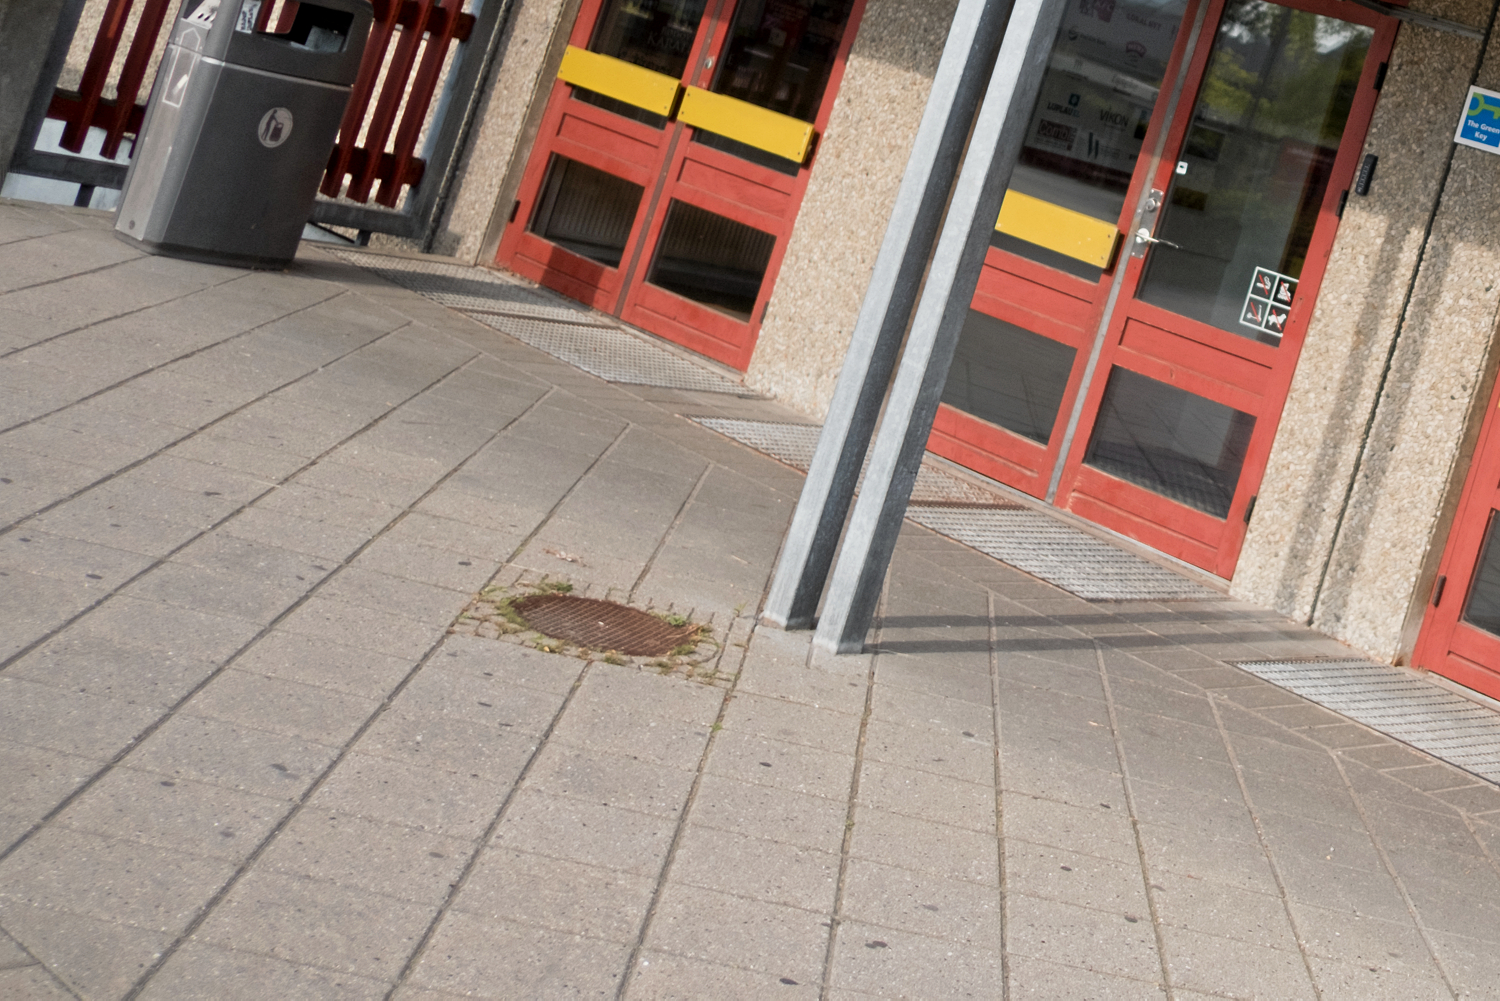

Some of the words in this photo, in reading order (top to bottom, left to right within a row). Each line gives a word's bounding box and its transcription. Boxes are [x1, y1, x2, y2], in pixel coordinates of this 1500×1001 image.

[1467, 119, 1480, 129] The
[1480, 123, 1500, 134] Green
[1474, 131, 1488, 141] Key
